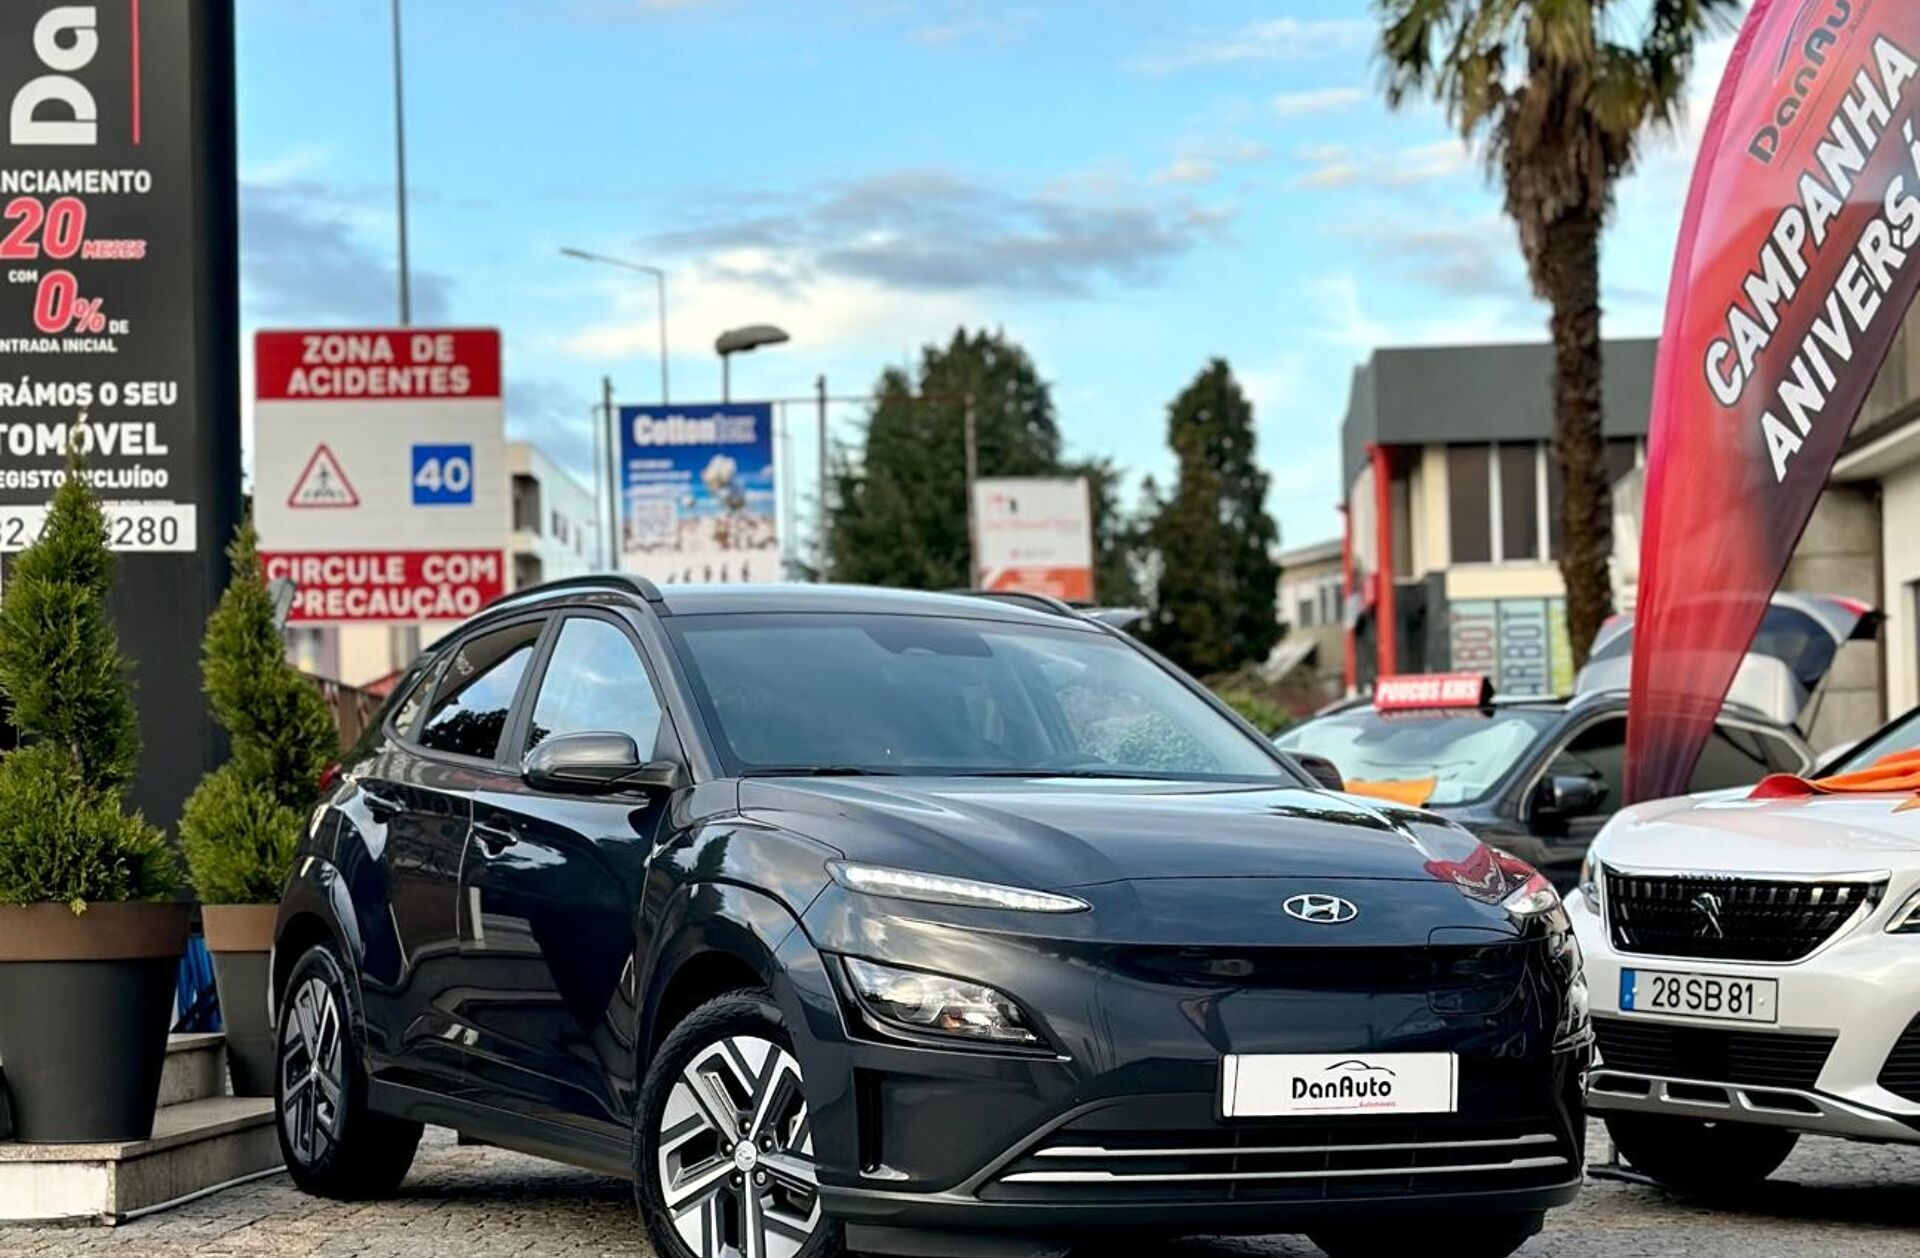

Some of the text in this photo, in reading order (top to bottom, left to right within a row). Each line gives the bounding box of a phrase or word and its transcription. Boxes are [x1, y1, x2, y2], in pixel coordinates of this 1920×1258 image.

[10, 6, 98, 145] Da
[1, 170, 152, 193] NCIAMENTO
[0, 196, 86, 259] 20
[1704, 35, 1918, 406] CAMPANHA
[8, 269, 129, 334] COM 0% DE
[1760, 117, 1920, 483] ANIVERS
[62, 338, 118, 352] INICIAL
[303, 335, 455, 364] ZONA DE
[0, 376, 178, 406] RÁMOS O SEU
[286, 366, 470, 395] ACIDENTES
[414, 457, 471, 493] 40
[267, 554, 497, 585] CIRCULE COM
[1292, 1075, 1392, 1099] DanAuto
